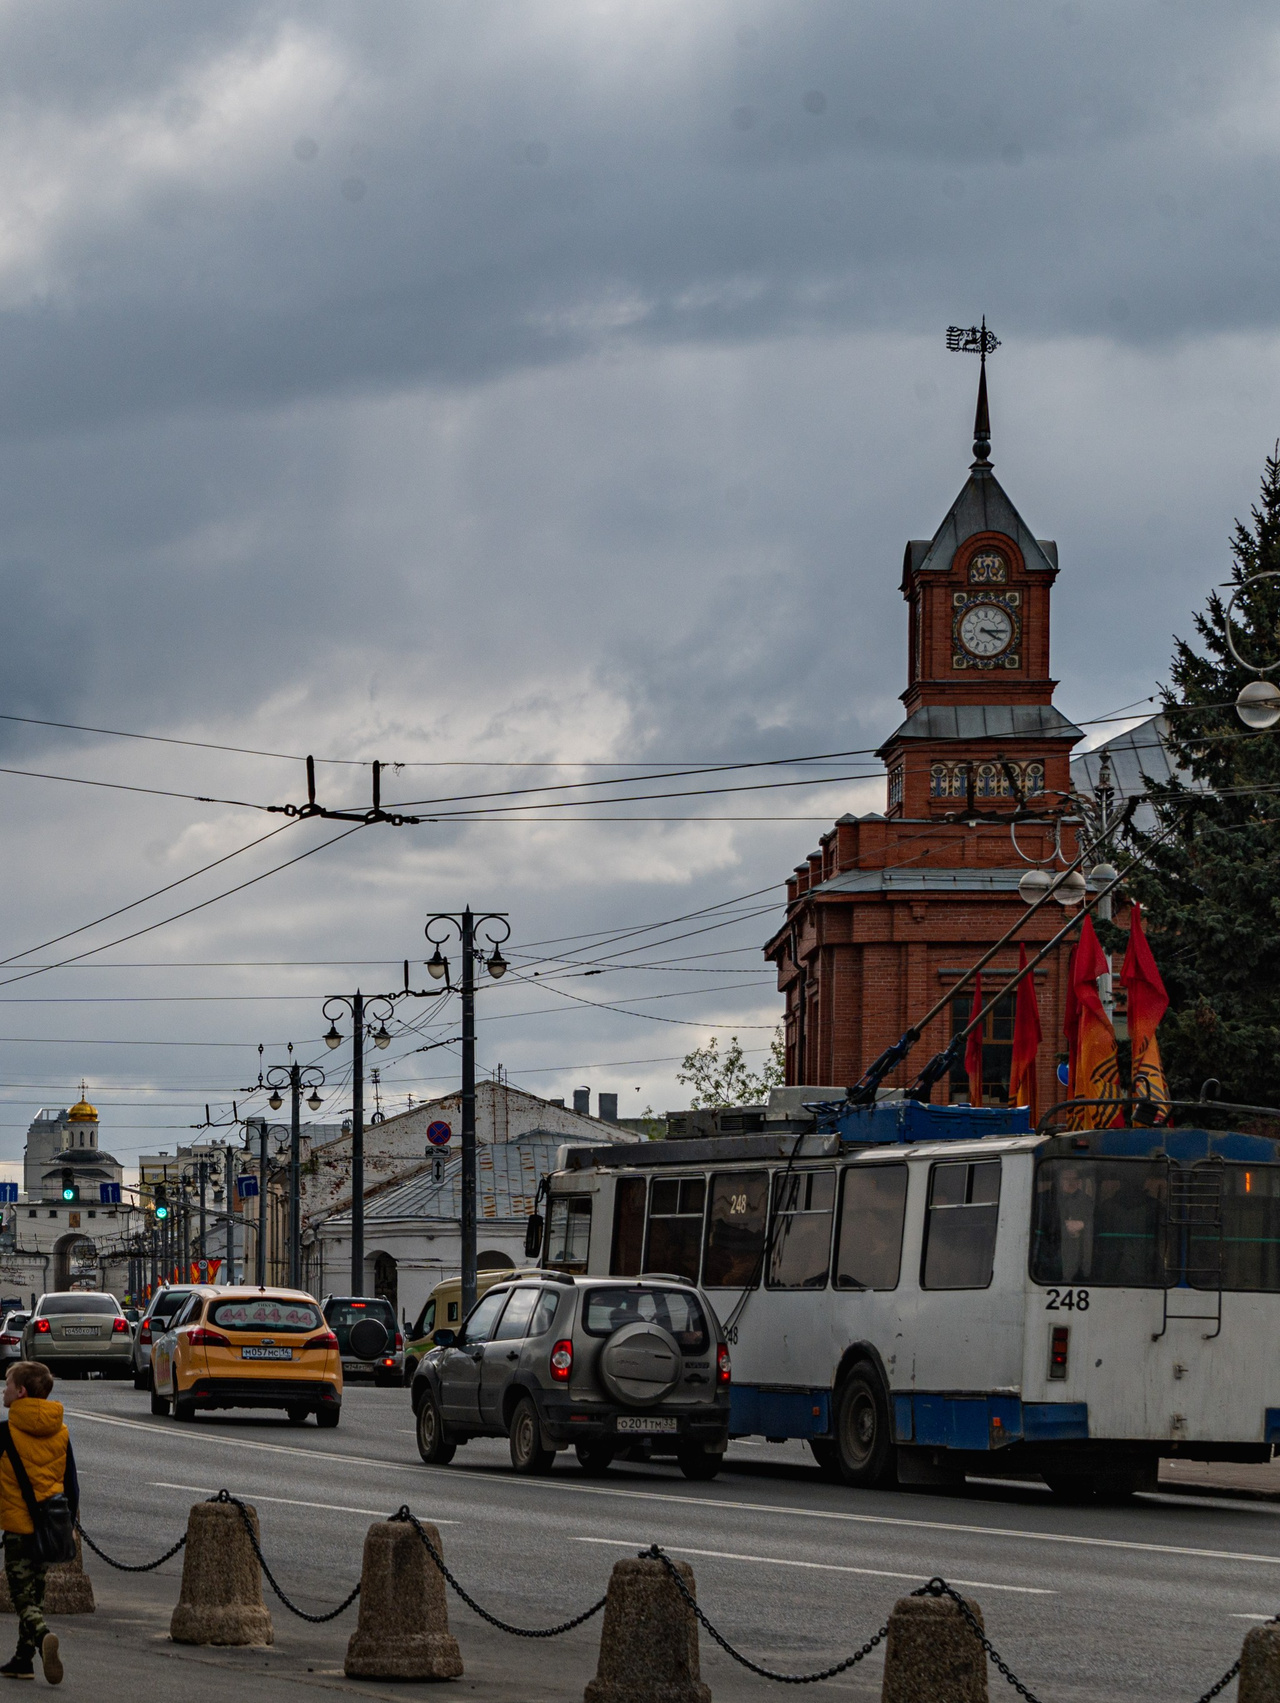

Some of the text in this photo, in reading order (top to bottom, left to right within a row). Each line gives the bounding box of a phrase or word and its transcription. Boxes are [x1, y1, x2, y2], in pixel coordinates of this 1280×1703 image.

[730, 1194, 747, 1214] 248
[1045, 1288, 1089, 1311] 248
[219, 1307, 313, 1326] 44 44 44
[723, 1326, 738, 1345] 248
